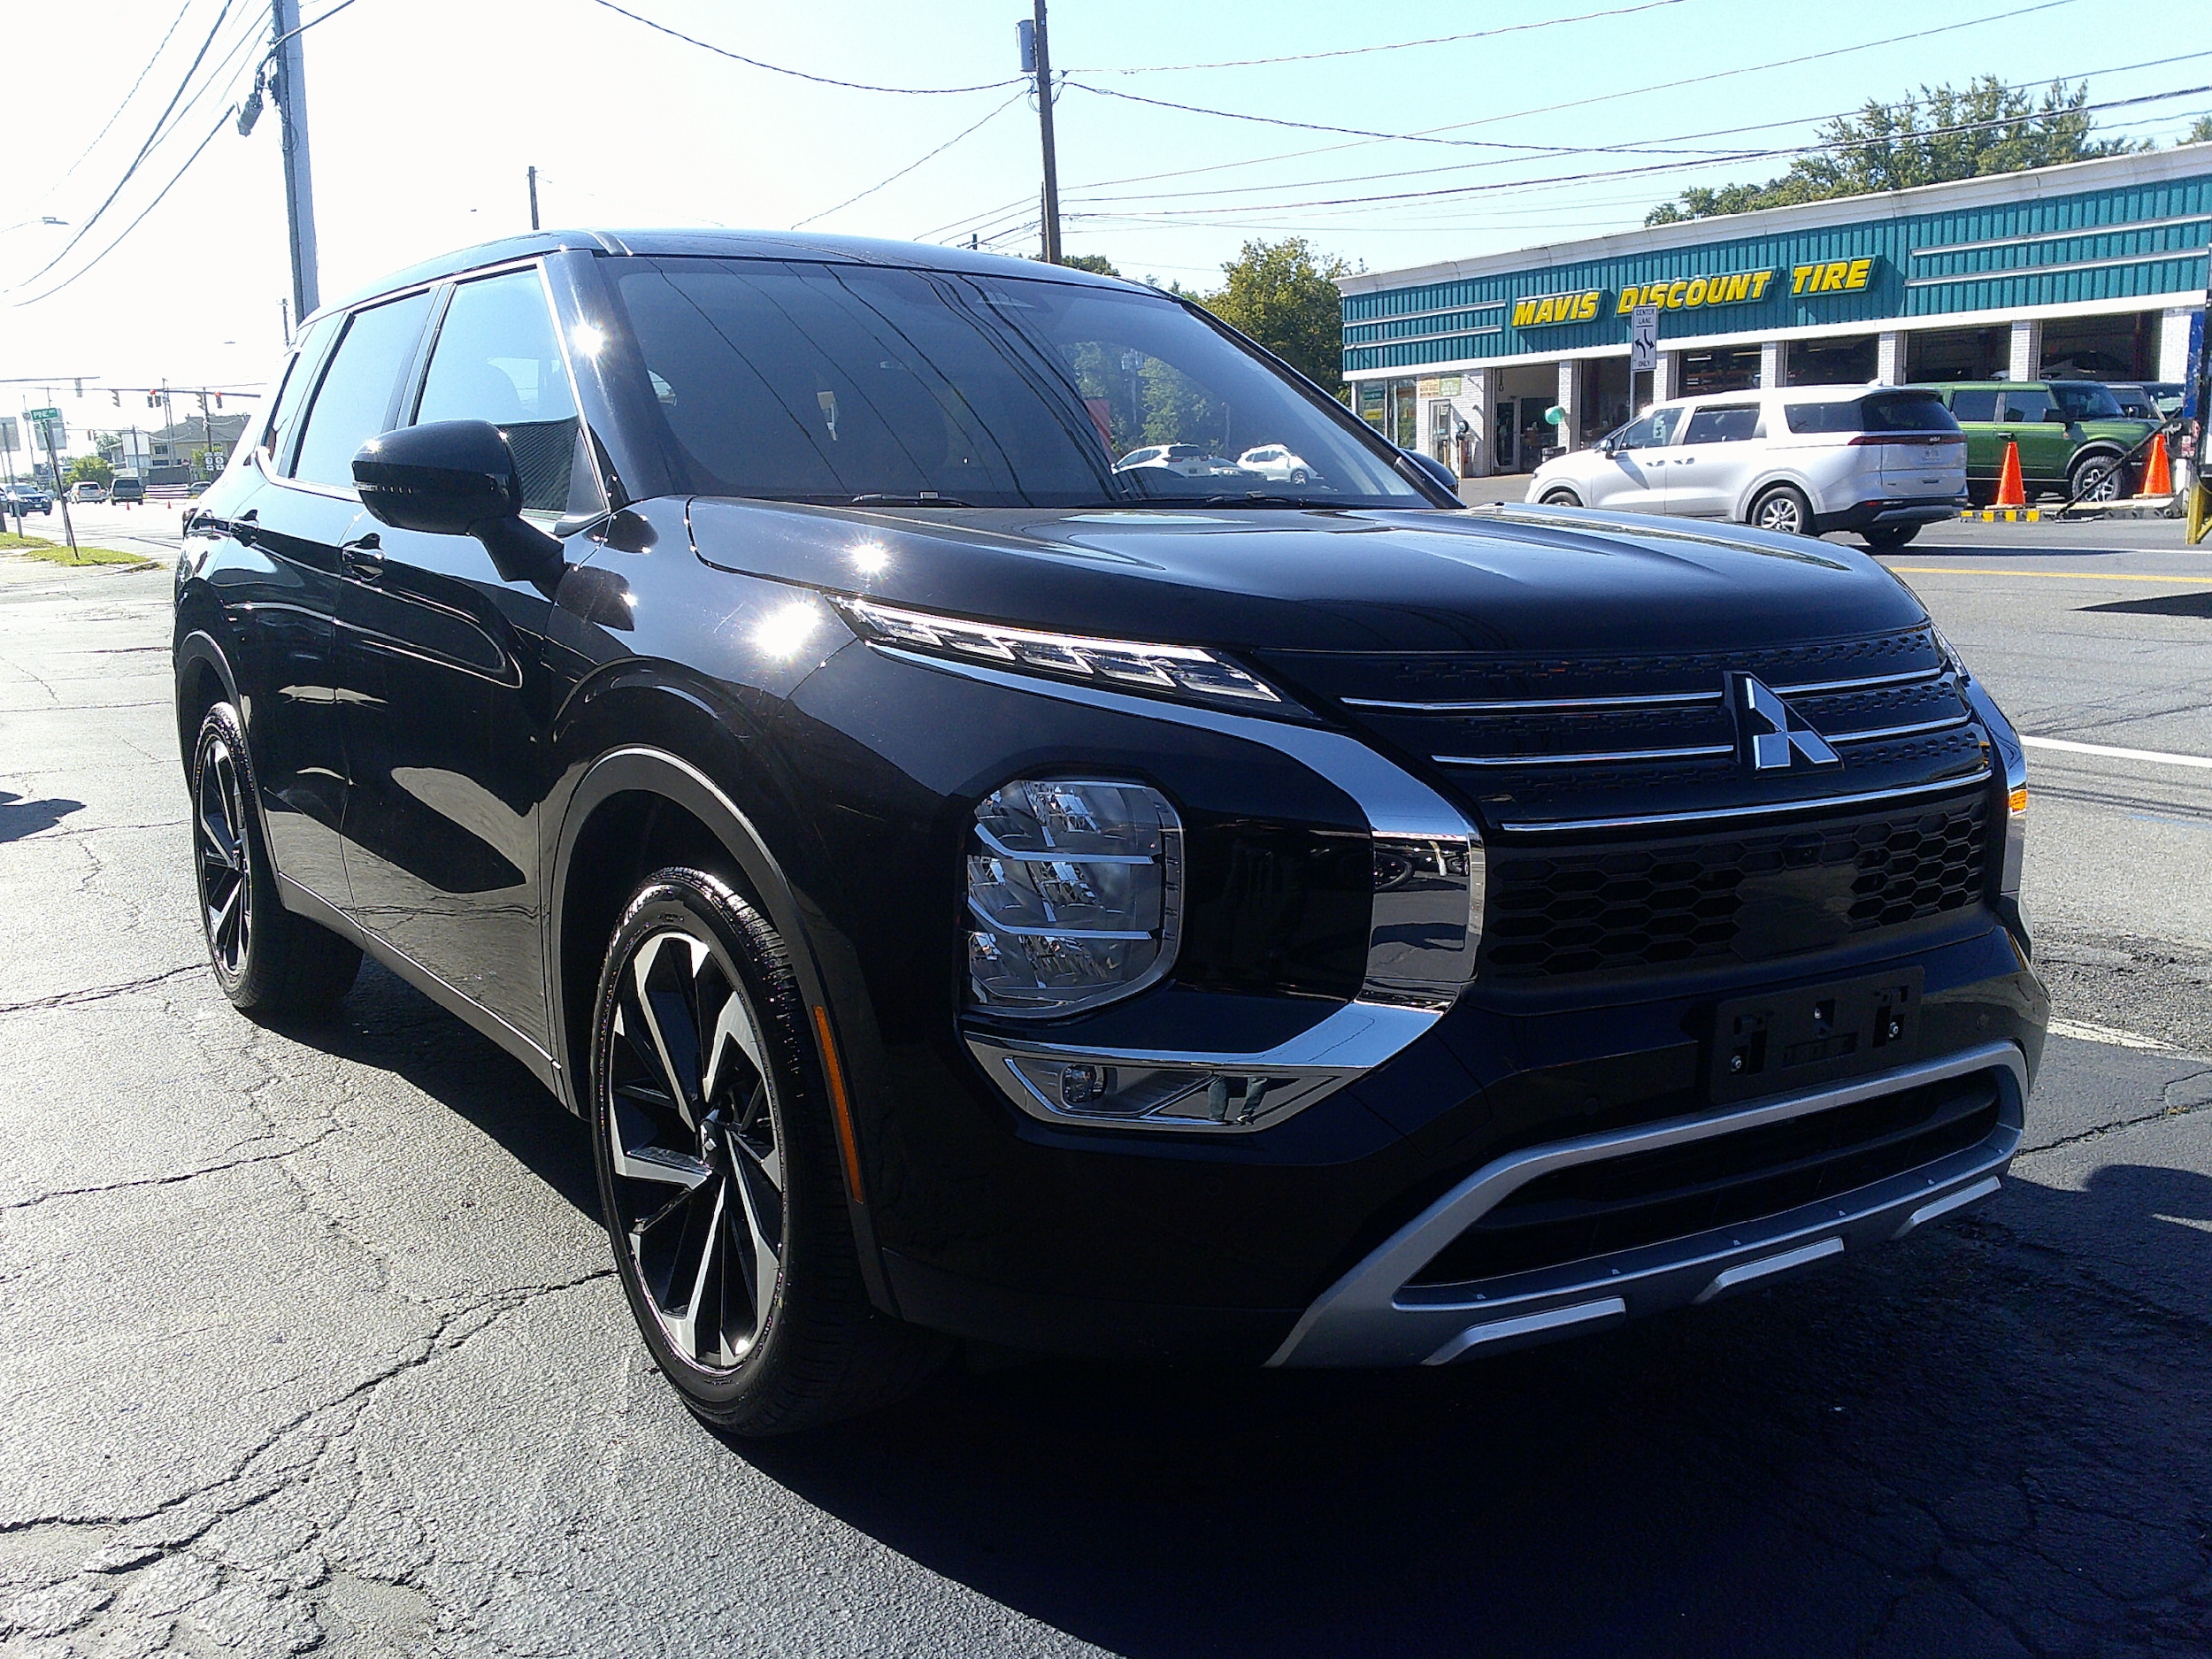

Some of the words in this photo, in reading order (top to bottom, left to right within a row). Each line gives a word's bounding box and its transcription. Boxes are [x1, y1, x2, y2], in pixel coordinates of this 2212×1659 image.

[1512, 292, 1600, 326] MAVIS
[1617, 271, 1772, 314] DISCOUNT
[1793, 258, 1872, 294] TIRE
